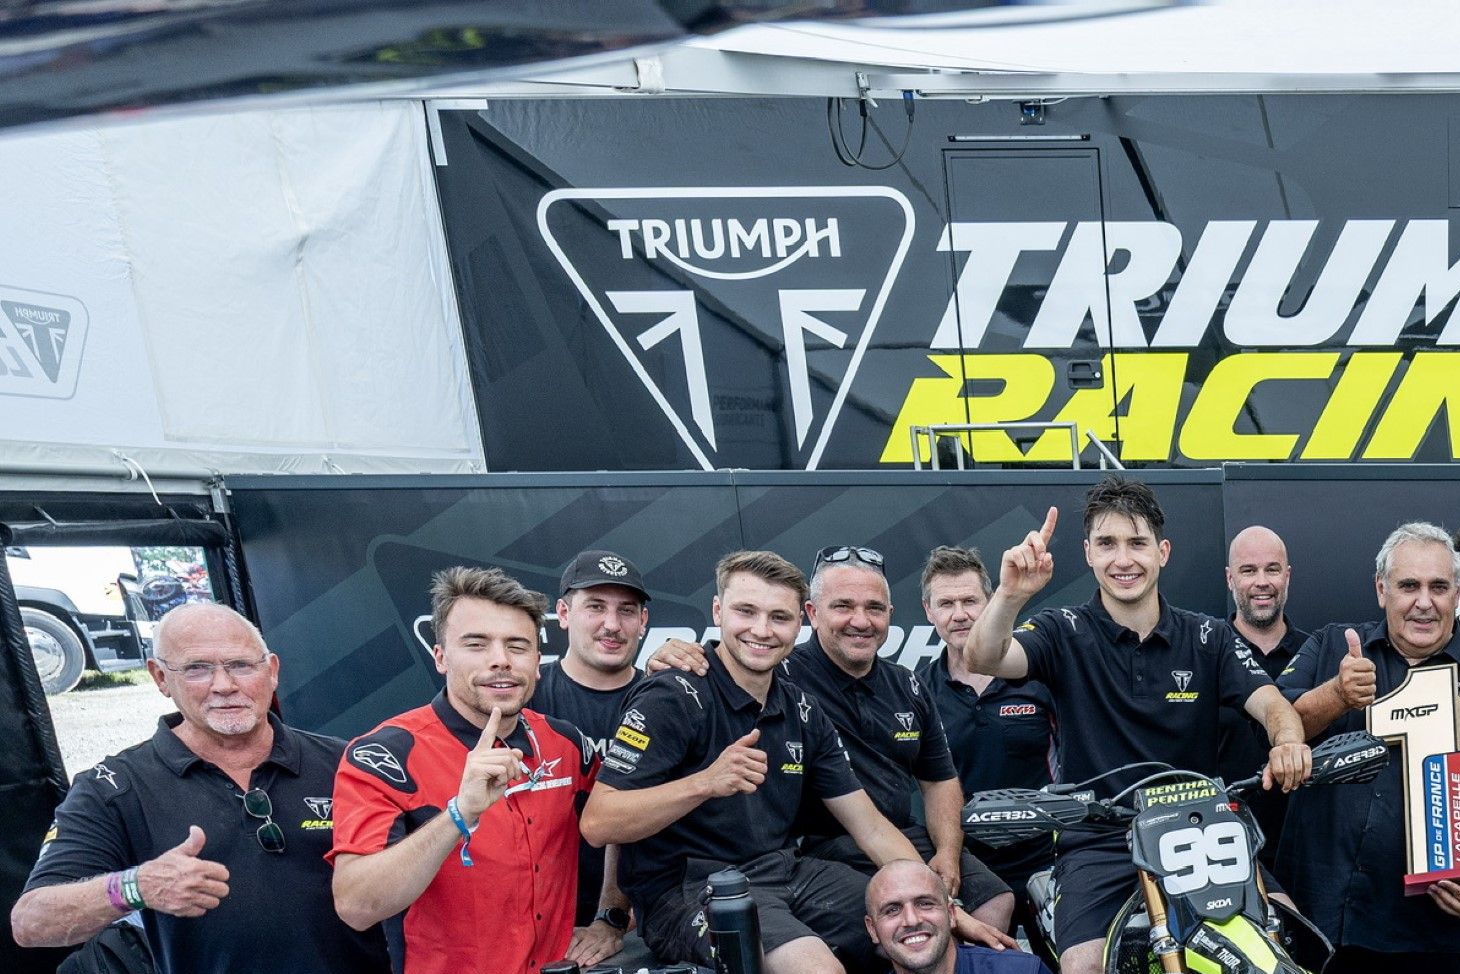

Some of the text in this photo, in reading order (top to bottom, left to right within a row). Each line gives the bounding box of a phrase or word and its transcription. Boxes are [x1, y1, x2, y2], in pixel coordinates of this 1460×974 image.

[607, 217, 842, 262] TRIUMPH
[1165, 692, 1199, 701] RACING
[1390, 703, 1439, 721] MXGP
[1334, 745, 1386, 768] ACERBIS
[1430, 761, 1445, 829] FRANCE
[966, 810, 1037, 822] ACERBIS
[1159, 821, 1251, 895] 99
[1434, 843, 1446, 869] GP
[1206, 898, 1233, 910] SKDA
